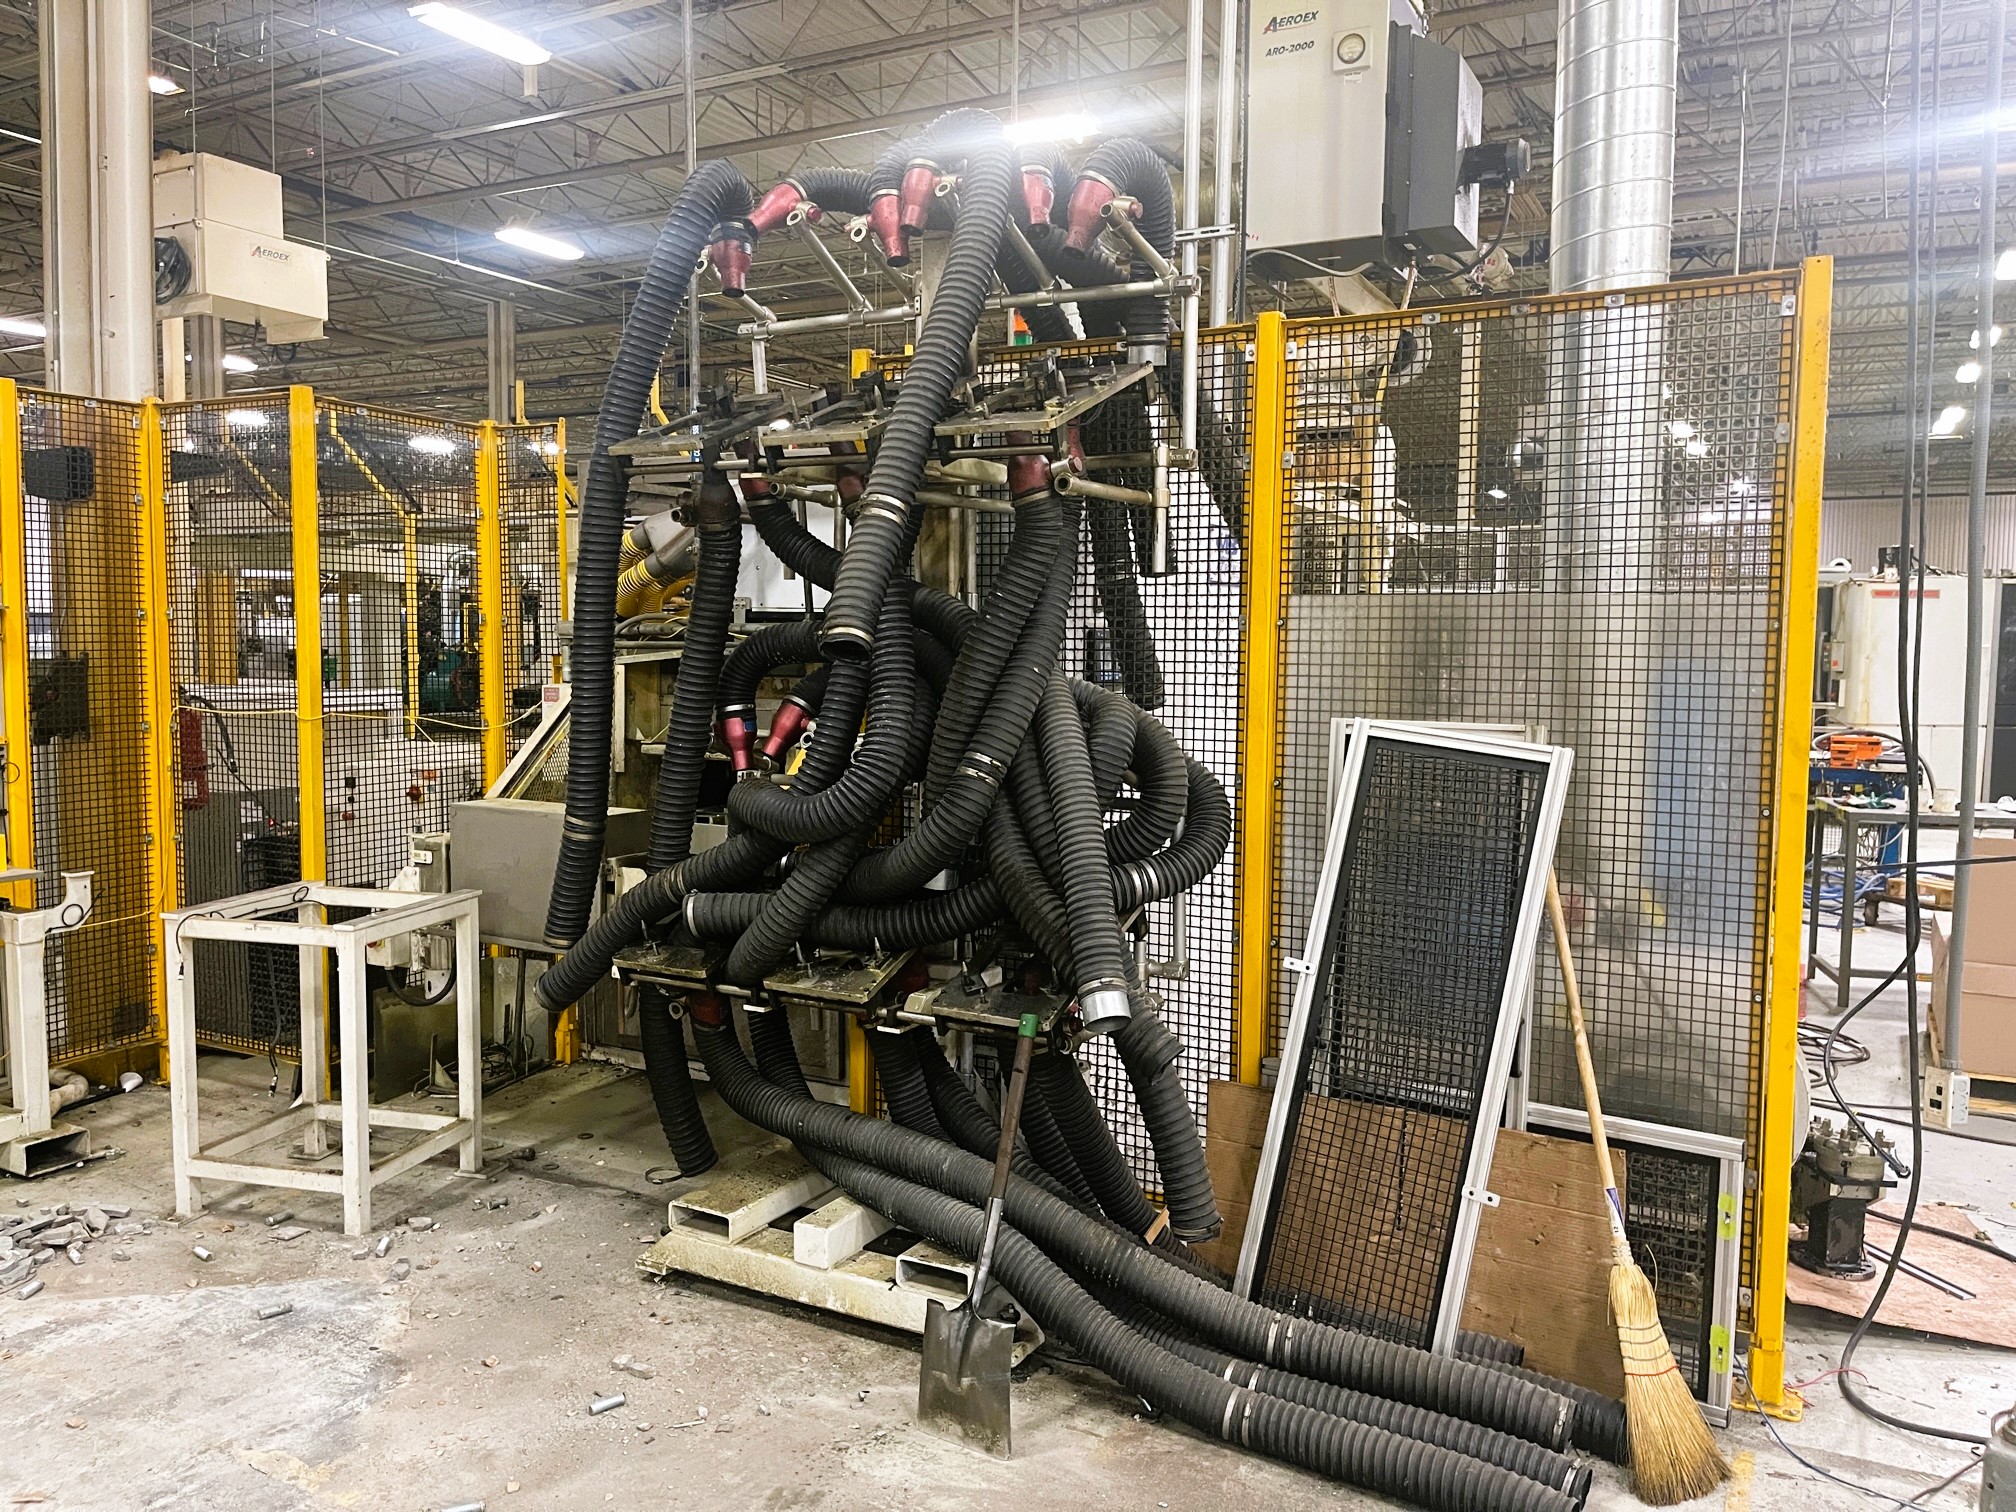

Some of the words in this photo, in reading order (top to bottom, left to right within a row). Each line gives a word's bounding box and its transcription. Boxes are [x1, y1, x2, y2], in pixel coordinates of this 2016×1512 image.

[1263, 11, 1319, 34] AEROEX
[1265, 40, 1315, 57] ARO-2000
[251, 246, 290, 261] AEROEX
